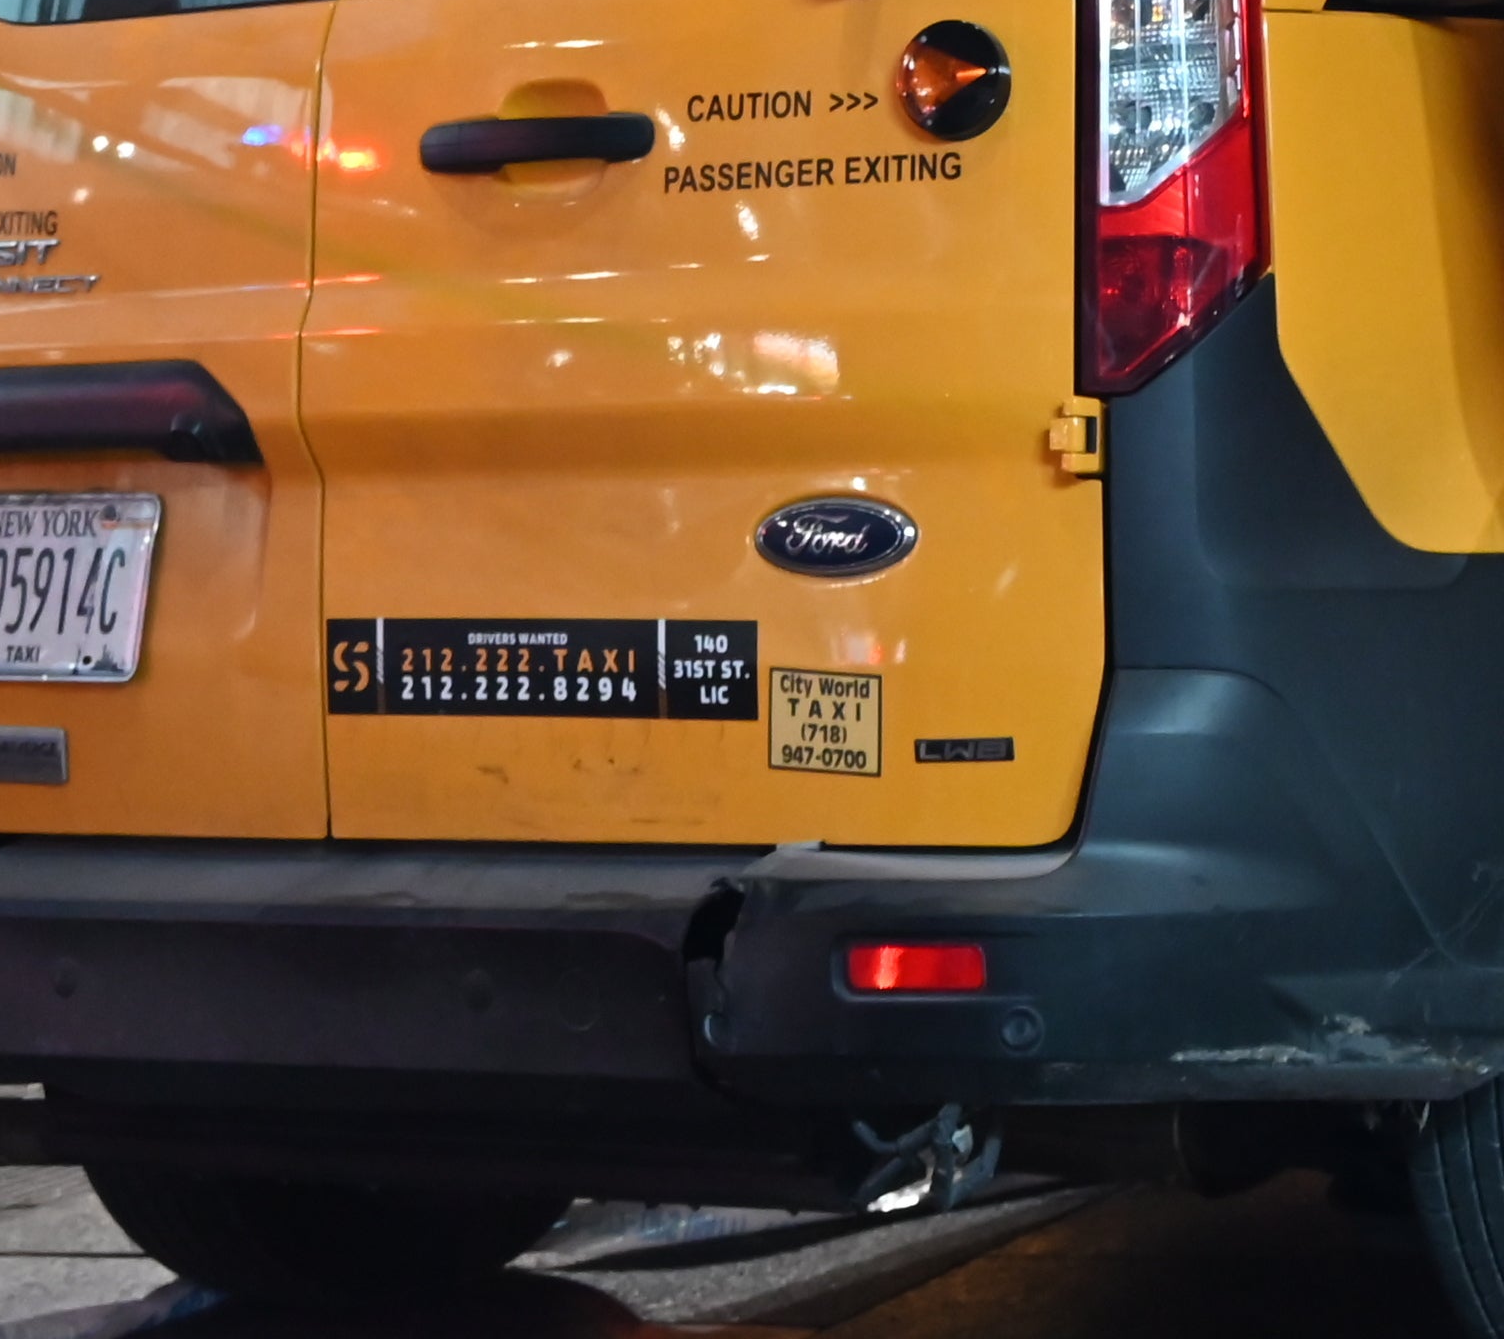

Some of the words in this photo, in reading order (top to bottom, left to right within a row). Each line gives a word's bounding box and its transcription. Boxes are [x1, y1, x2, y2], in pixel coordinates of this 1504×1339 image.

[686, 90, 813, 123] CAUTION
[663, 157, 836, 194] PASSENGER
[845, 152, 962, 184] EXITING
[40, 509, 100, 537] YORK
[785, 513, 872, 555] Ford
[467, 632, 517, 646] DRIVERS
[518, 633, 569, 646] WANTED
[694, 634, 729, 654] 140
[5, 644, 41, 664] TAXI
[673, 660, 717, 679] 31ST
[720, 660, 751, 679] ST.
[700, 685, 729, 705] LIC
[779, 674, 813, 697] City
[818, 676, 871, 699] World
[786, 698, 862, 722] TAXI
[800, 723, 848, 744] (718)
[781, 744, 868, 770] 947-0700
[918, 739, 1009, 761] LWB
